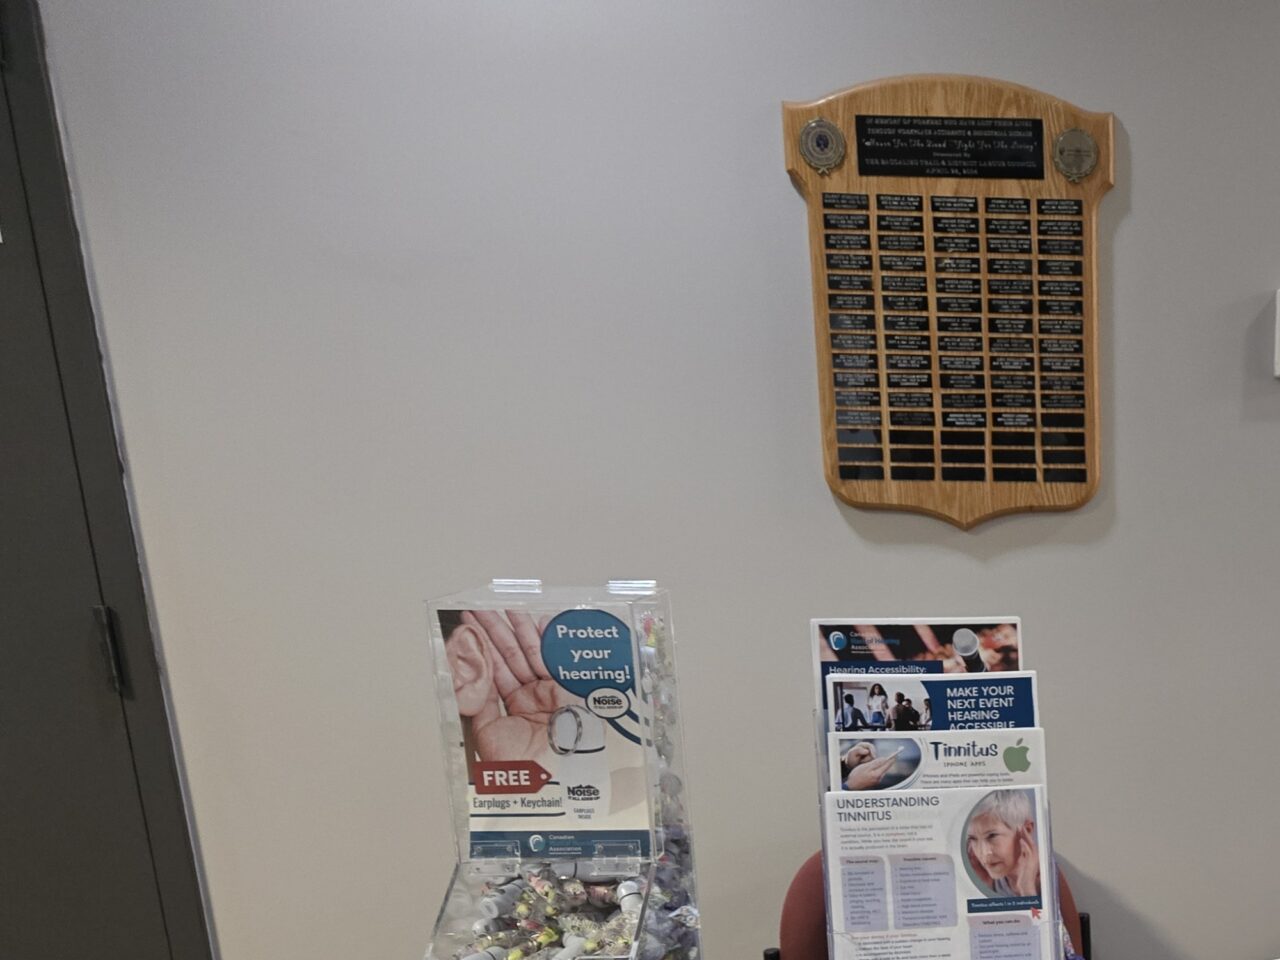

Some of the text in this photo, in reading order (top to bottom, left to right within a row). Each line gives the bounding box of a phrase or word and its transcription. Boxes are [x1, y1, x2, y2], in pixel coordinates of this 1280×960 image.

[555, 624, 620, 639] Protect
[570, 649, 611, 663] your
[557, 664, 631, 683] hearing!
[829, 665, 927, 674] Hearing Accessibility:
[946, 686, 1014, 697] MAKE YOUR
[947, 698, 1014, 709] NEXT EVENT
[948, 710, 1000, 721] HEARING
[929, 740, 999, 760] Tinnitus
[482, 770, 531, 786] FREE
[472, 797, 511, 810] Earplugs
[520, 797, 563, 809] Keychain!
[836, 796, 940, 809] UNDERSTANDING
[837, 811, 892, 822] TINNITUS
